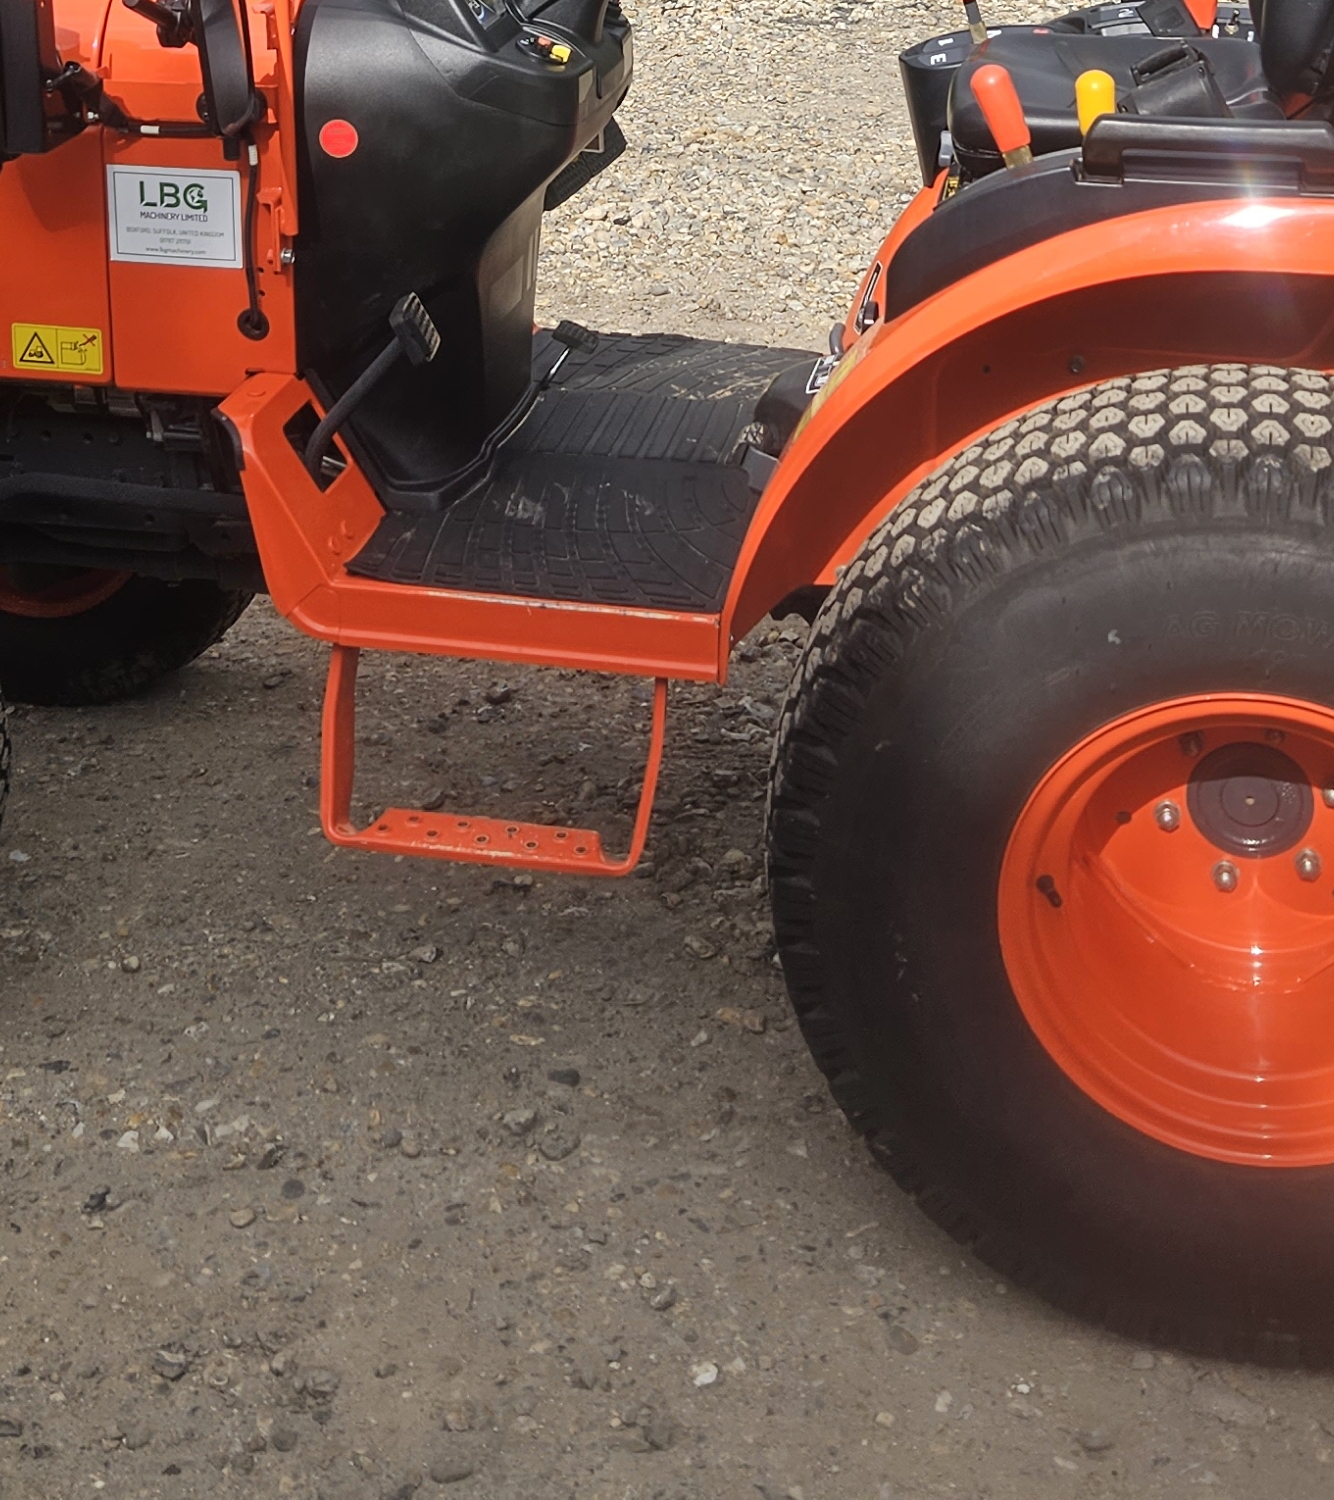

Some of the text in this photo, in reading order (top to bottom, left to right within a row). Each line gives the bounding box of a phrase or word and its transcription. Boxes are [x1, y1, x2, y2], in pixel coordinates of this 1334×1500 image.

[139, 180, 208, 213] LBG
[140, 211, 208, 222] MACHINERY LIMITED
